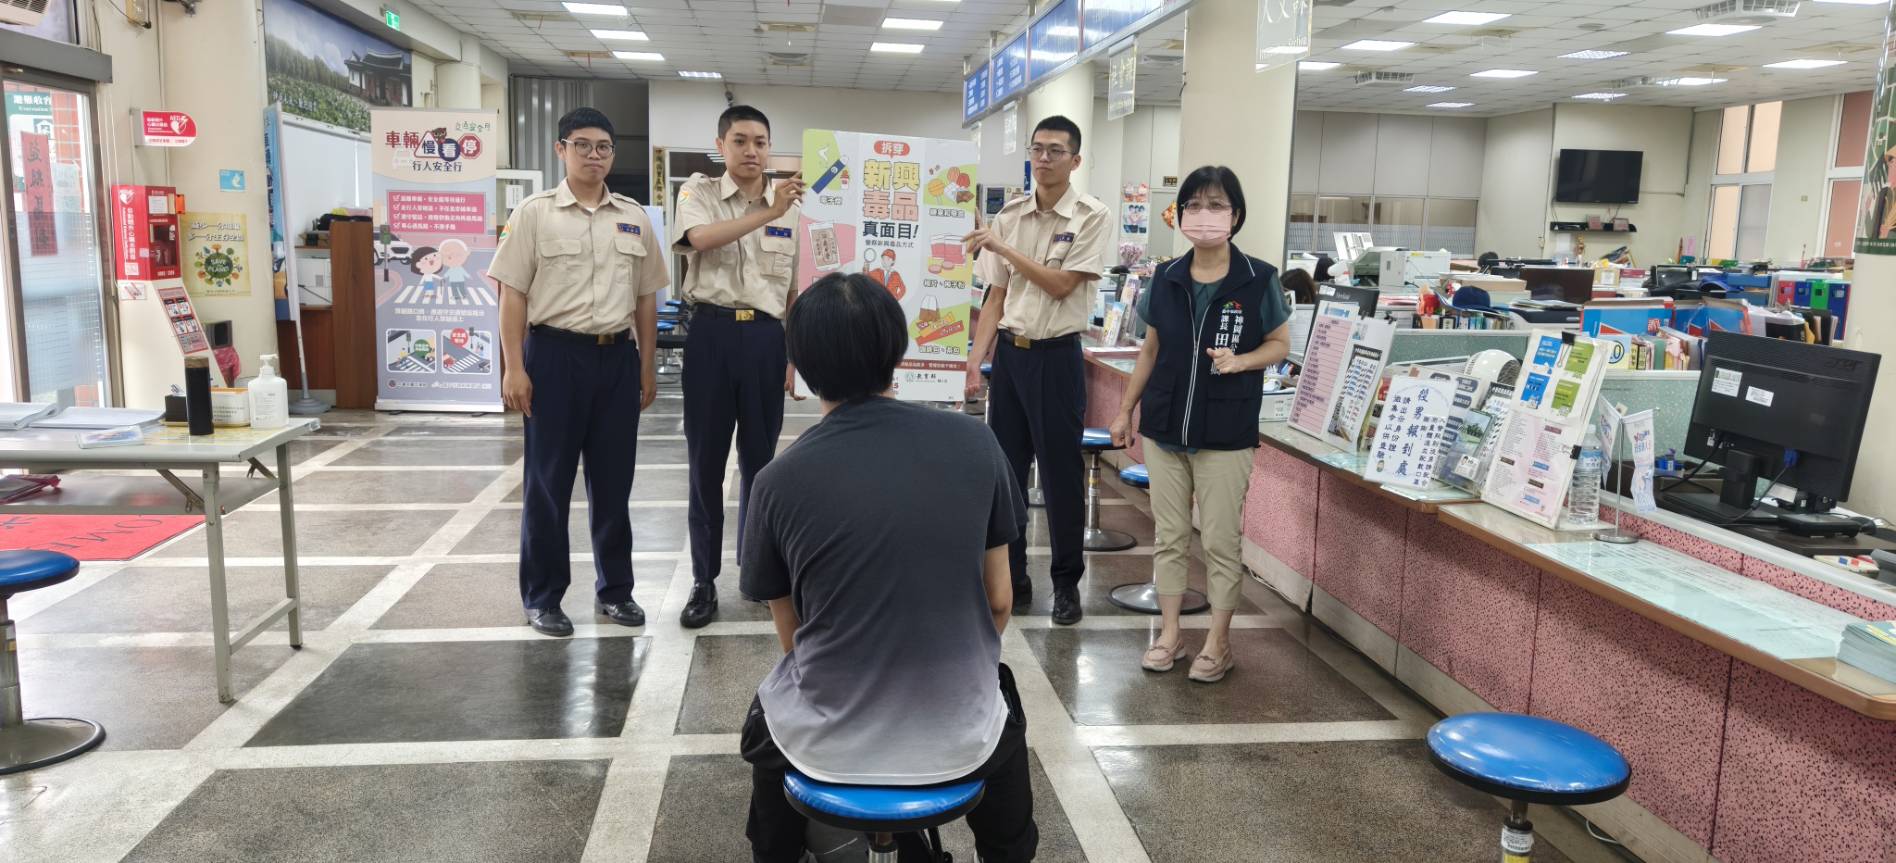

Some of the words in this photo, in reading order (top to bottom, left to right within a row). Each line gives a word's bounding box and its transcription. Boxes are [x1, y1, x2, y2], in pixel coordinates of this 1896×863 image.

[412, 160, 464, 172] 行人安全行
[863, 159, 921, 191] 新興
[863, 190, 919, 221] 毒品
[863, 221, 919, 239] 真面目!
[1395, 388, 1430, 477] 役男報到處
